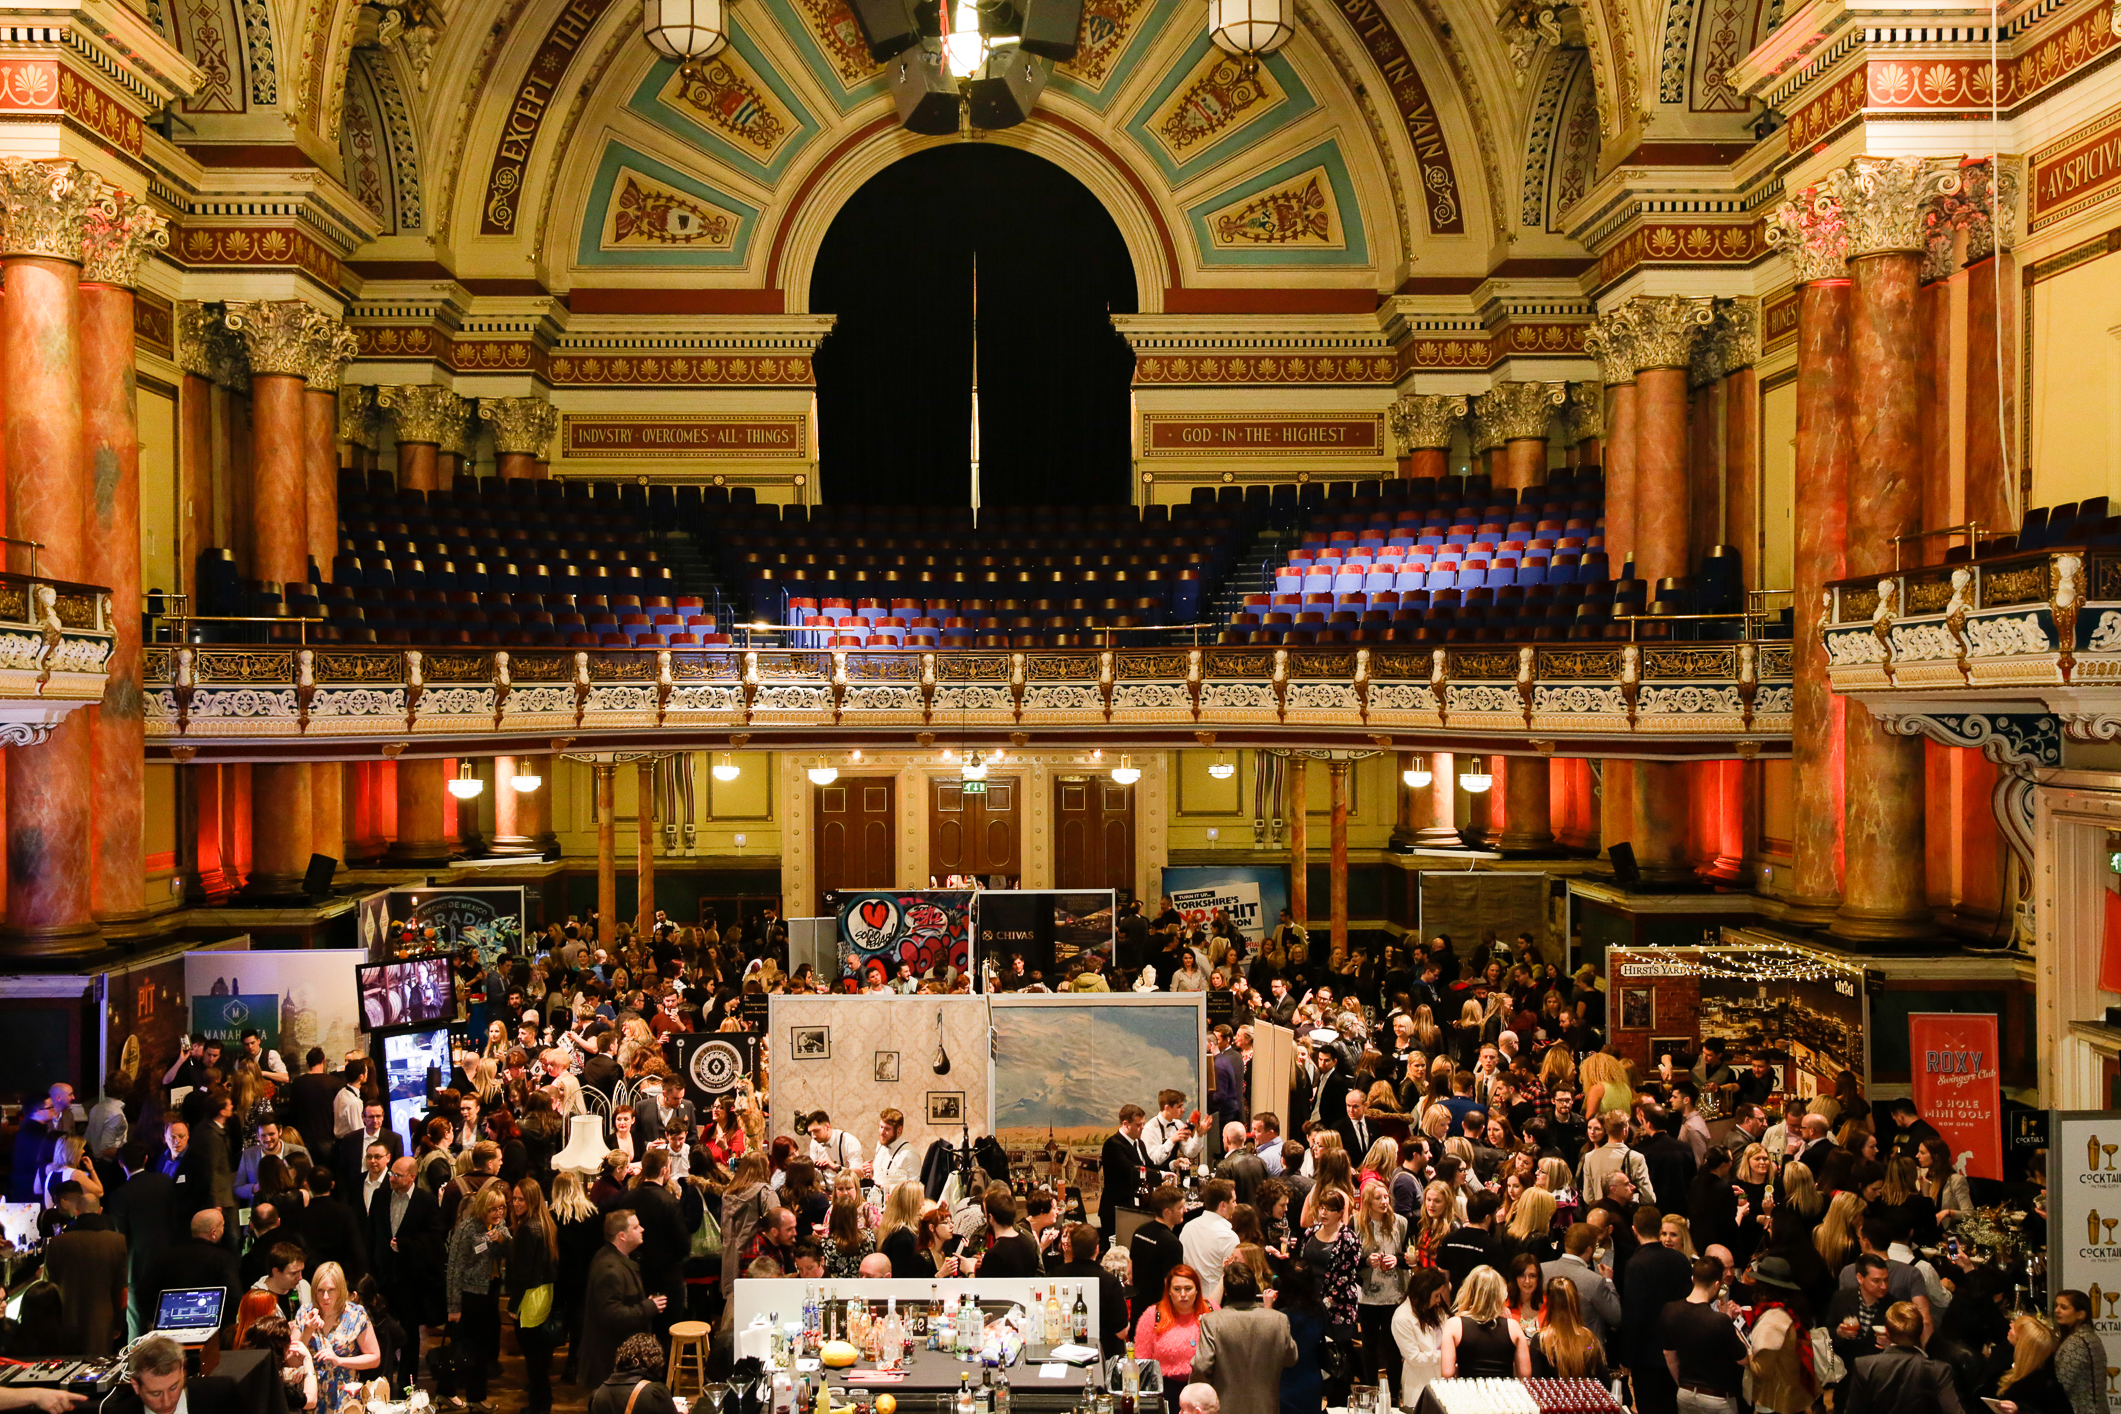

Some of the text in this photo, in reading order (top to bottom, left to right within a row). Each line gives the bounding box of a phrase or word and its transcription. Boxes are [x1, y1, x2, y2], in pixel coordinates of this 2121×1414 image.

[500, 2, 597, 163] EXCEPT THE
[1383, 54, 1414, 86] IN
[1407, 101, 1444, 160] VAIN
[2046, 136, 2121, 201] AVSPICIV
[578, 427, 790, 444] INDVSTRY OVERCOMES ALL THINGS
[1182, 427, 1347, 443] GOD IN THE HIGHEST
[1174, 895, 1240, 910] YORKSHIRE'S
[1179, 893, 1194, 901] TURN
[422, 903, 447, 916] HECHO
[448, 901, 460, 909] DE
[1223, 902, 1259, 919] HIT
[996, 930, 1035, 940] CHIVAS
[1623, 964, 1660, 976] HIRST'S
[232, 1007, 240, 1018] M
[203, 1029, 268, 1041] MANAHA
[1926, 1050, 1984, 1074] ROXY
[1937, 1068, 1997, 1089] Swingers Club
[1947, 1099, 1979, 1109] HOLE
[1924, 1109, 1991, 1119] MINI GOLF
